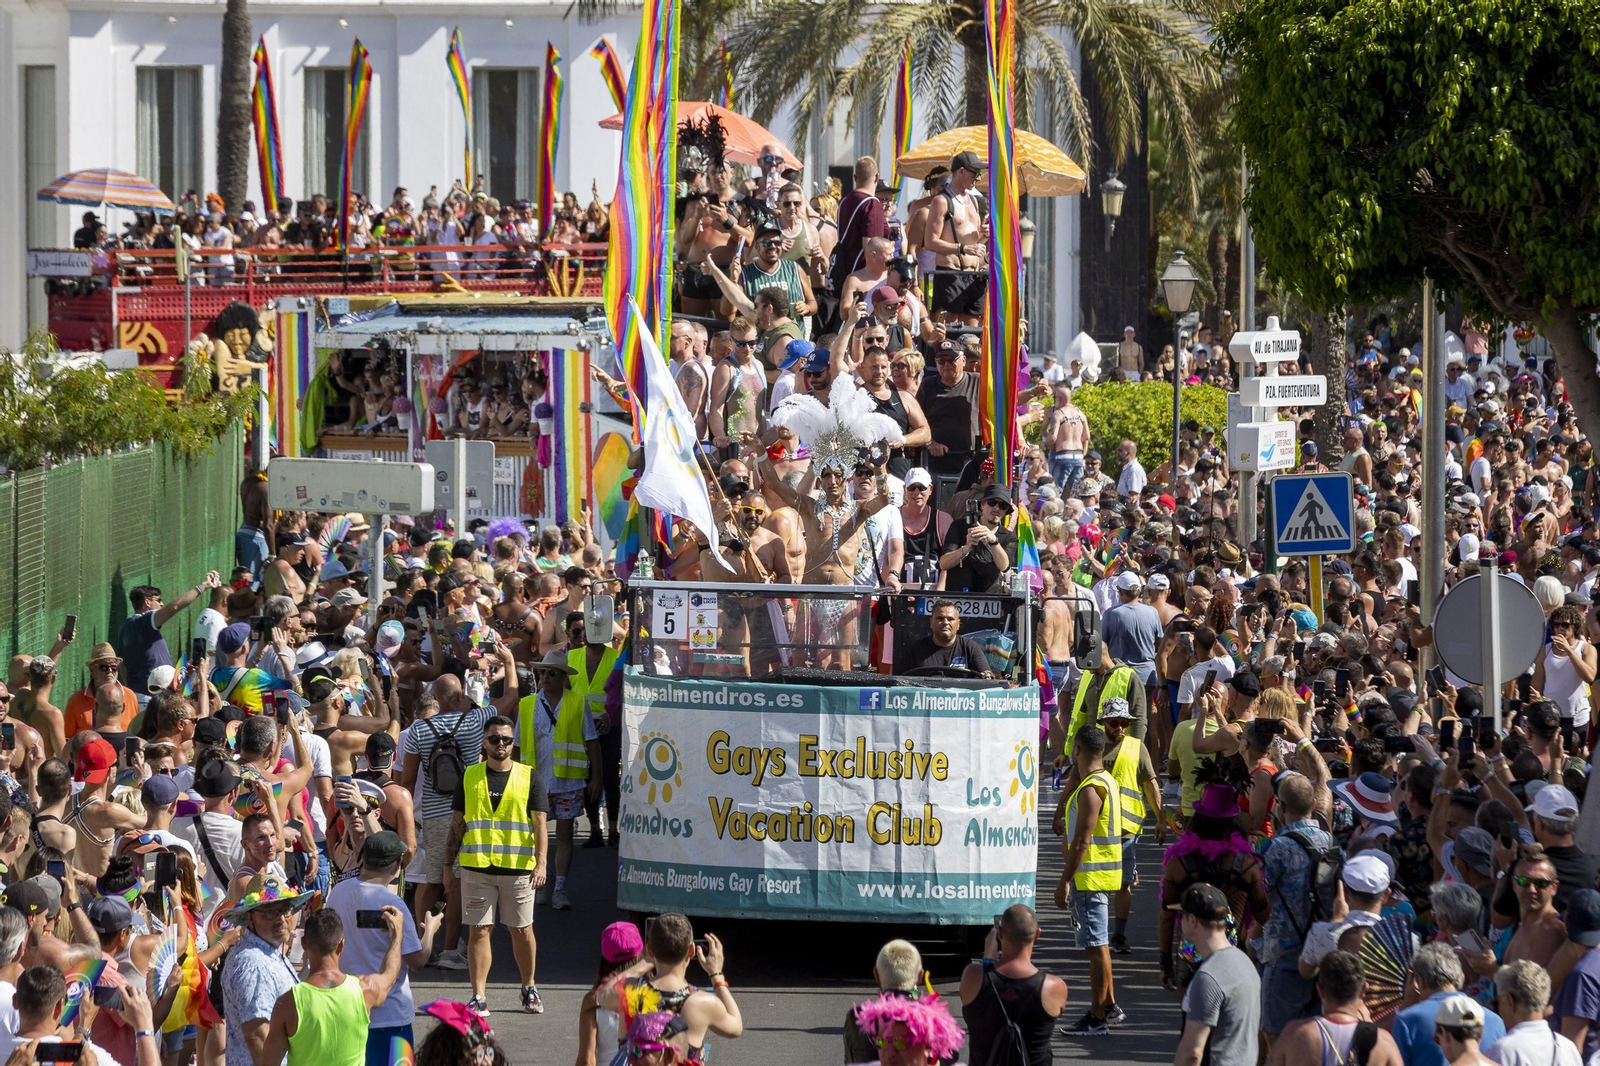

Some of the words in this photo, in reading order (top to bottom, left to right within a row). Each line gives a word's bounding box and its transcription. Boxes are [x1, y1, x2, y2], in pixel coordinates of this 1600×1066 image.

[1254, 340, 1264, 354] AV.
[1264, 341, 1271, 353] de
[1272, 339, 1298, 353] TIRAJANA
[1265, 385, 1277, 399] PZA.
[1278, 384, 1320, 398] FUERTEVENTURA
[982, 601, 1000, 616] AU
[664, 611, 675, 635] 5
[884, 690, 908, 711] Los
[912, 690, 976, 712] Almendros
[979, 691, 1023, 715] Bungalows
[706, 730, 786, 787] Gays
[798, 734, 949, 782] Exclusive
[966, 777, 1002, 808] Los
[708, 796, 854, 847] Vacation
[866, 801, 943, 847] Club
[627, 864, 665, 887] Almendros
[667, 868, 725, 893] Bungalows
[729, 872, 753, 896] Gay
[757, 873, 801, 895] Resort
